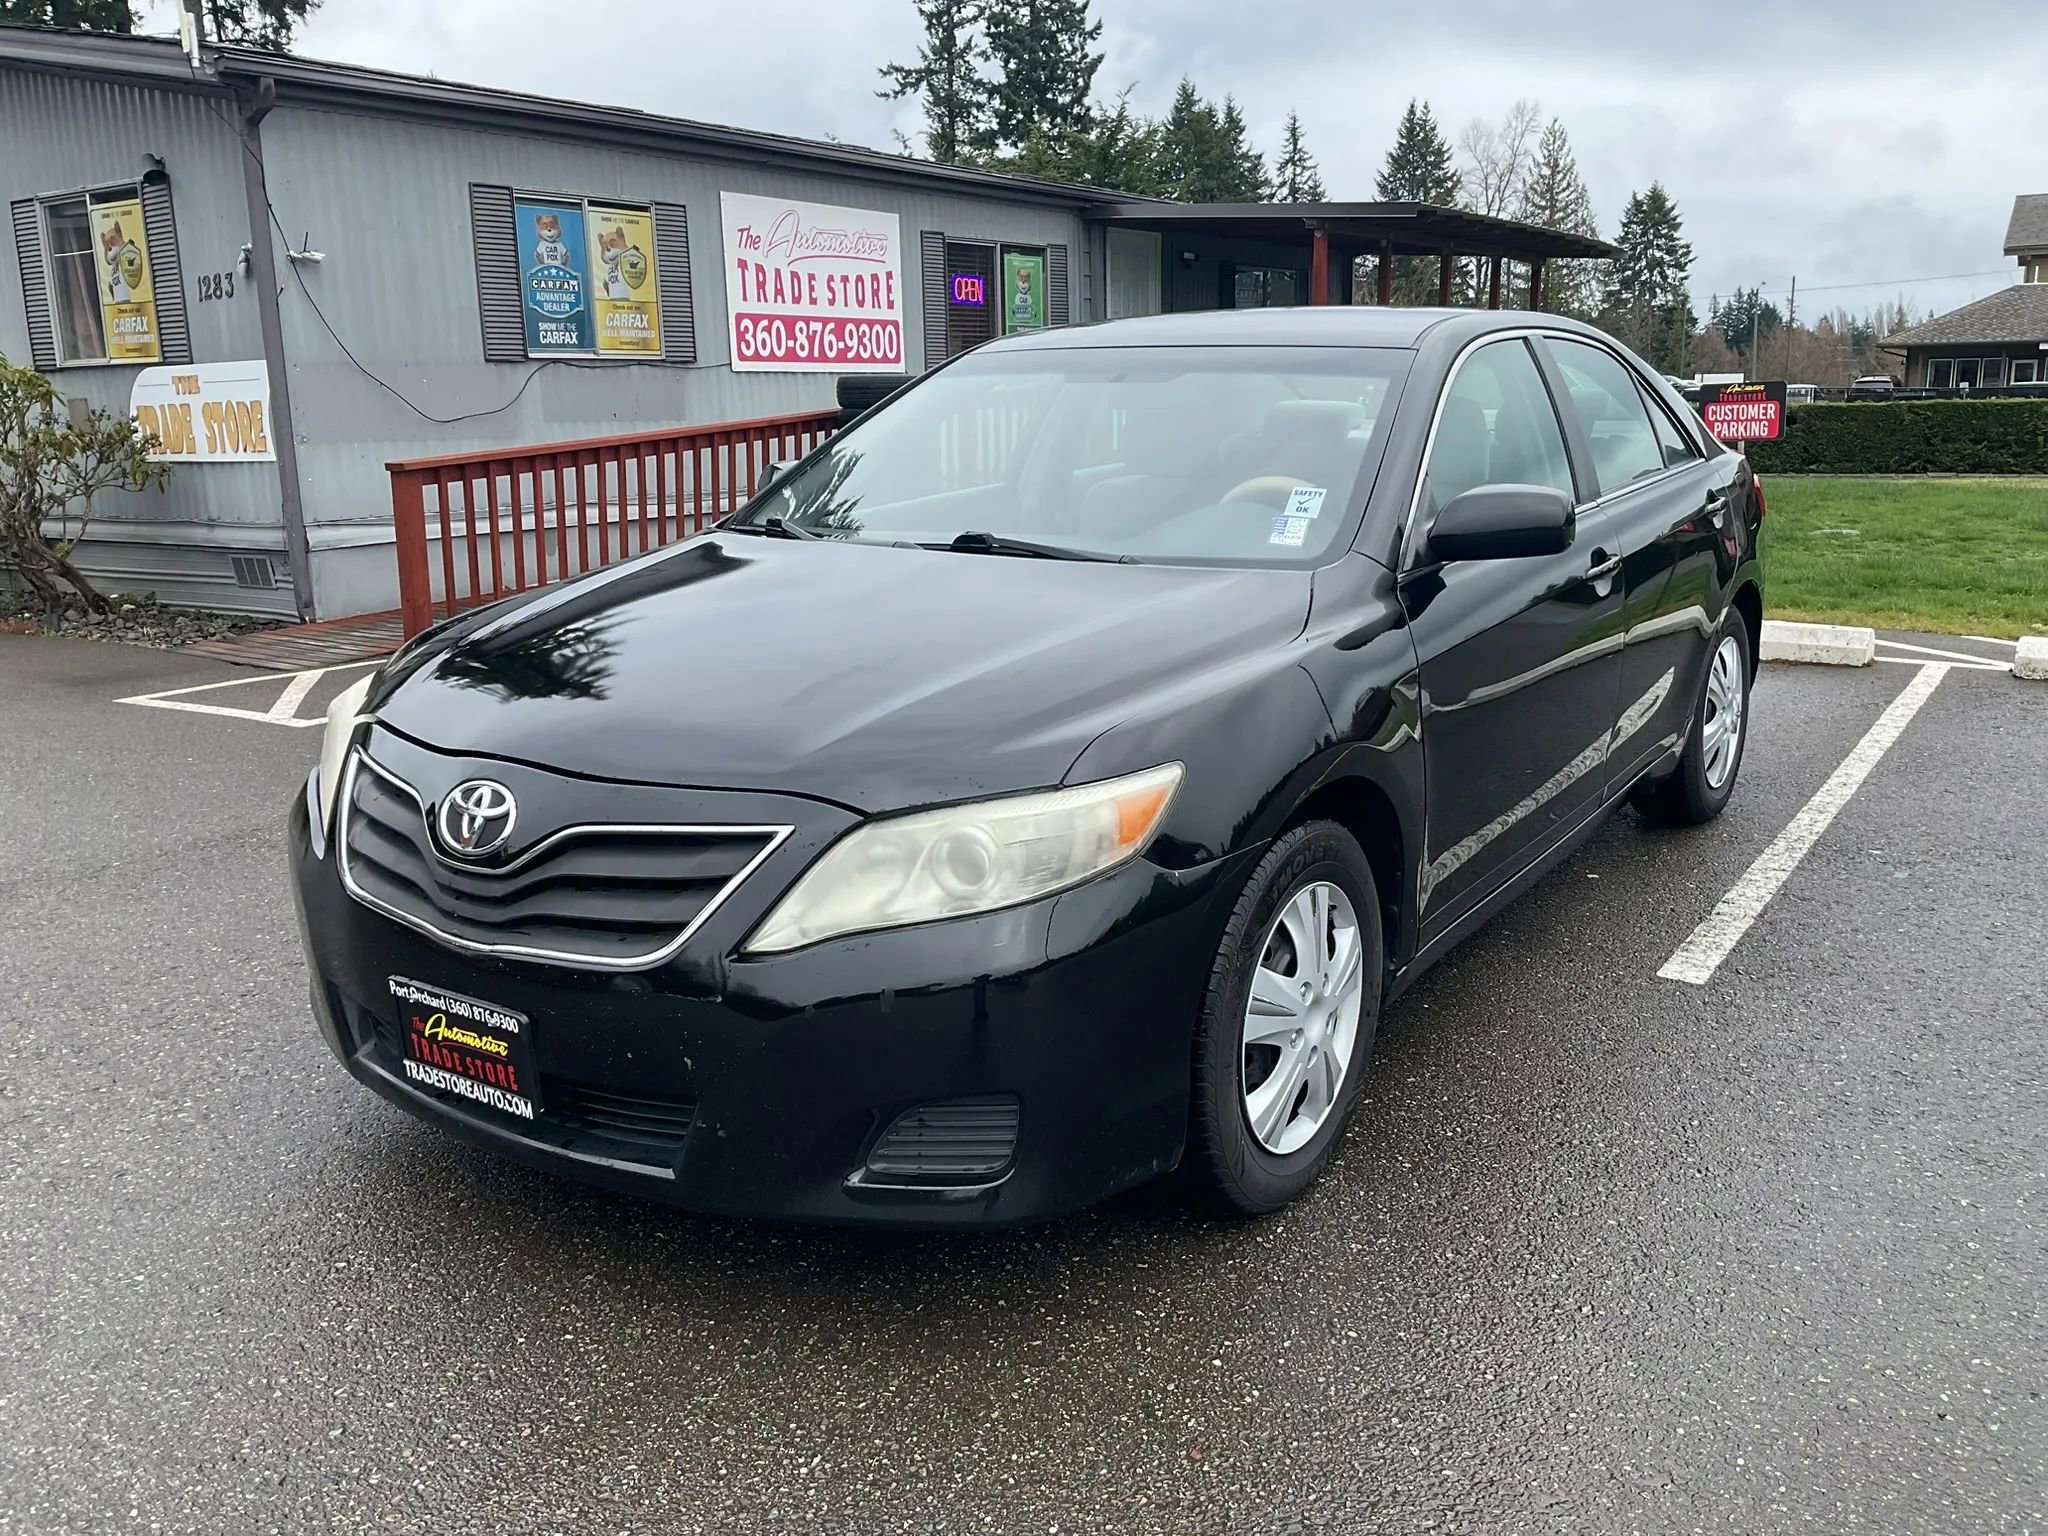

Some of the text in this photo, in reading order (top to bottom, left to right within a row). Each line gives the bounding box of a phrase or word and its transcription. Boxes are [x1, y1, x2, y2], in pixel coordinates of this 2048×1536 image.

[737, 210, 888, 258] The Automotive
[545, 246, 558, 254] CAR
[197, 272, 235, 302] 1283
[531, 279, 578, 292] CARFAX
[737, 258, 895, 310] TRADE STORE
[955, 277, 983, 302] OPEN
[536, 291, 576, 303] ADVANTAGE
[543, 303, 570, 312] DEALER
[113, 315, 148, 333] CARFAX
[538, 322, 577, 331] SHOW ME THE
[606, 312, 649, 328] CARFAX
[539, 331, 578, 344] CARFAX
[740, 318, 897, 359] 360-876-9300
[171, 374, 201, 396] THE
[1744, 392, 1767, 401] STORE
[1709, 404, 1775, 420] CUSTOMER
[135, 400, 267, 455] TRADE STORE
[1714, 421, 1768, 437] PARKING
[1293, 489, 1323, 498] SAFETY
[389, 980, 409, 999] Port
[409, 987, 446, 1010] Orchard
[446, 997, 472, 1019] (360)
[411, 1013, 509, 1056] The Automotive
[411, 1033, 519, 1091] TRADE STORE
[402, 1058, 534, 1120] TRADESTOREAUTO.COM
